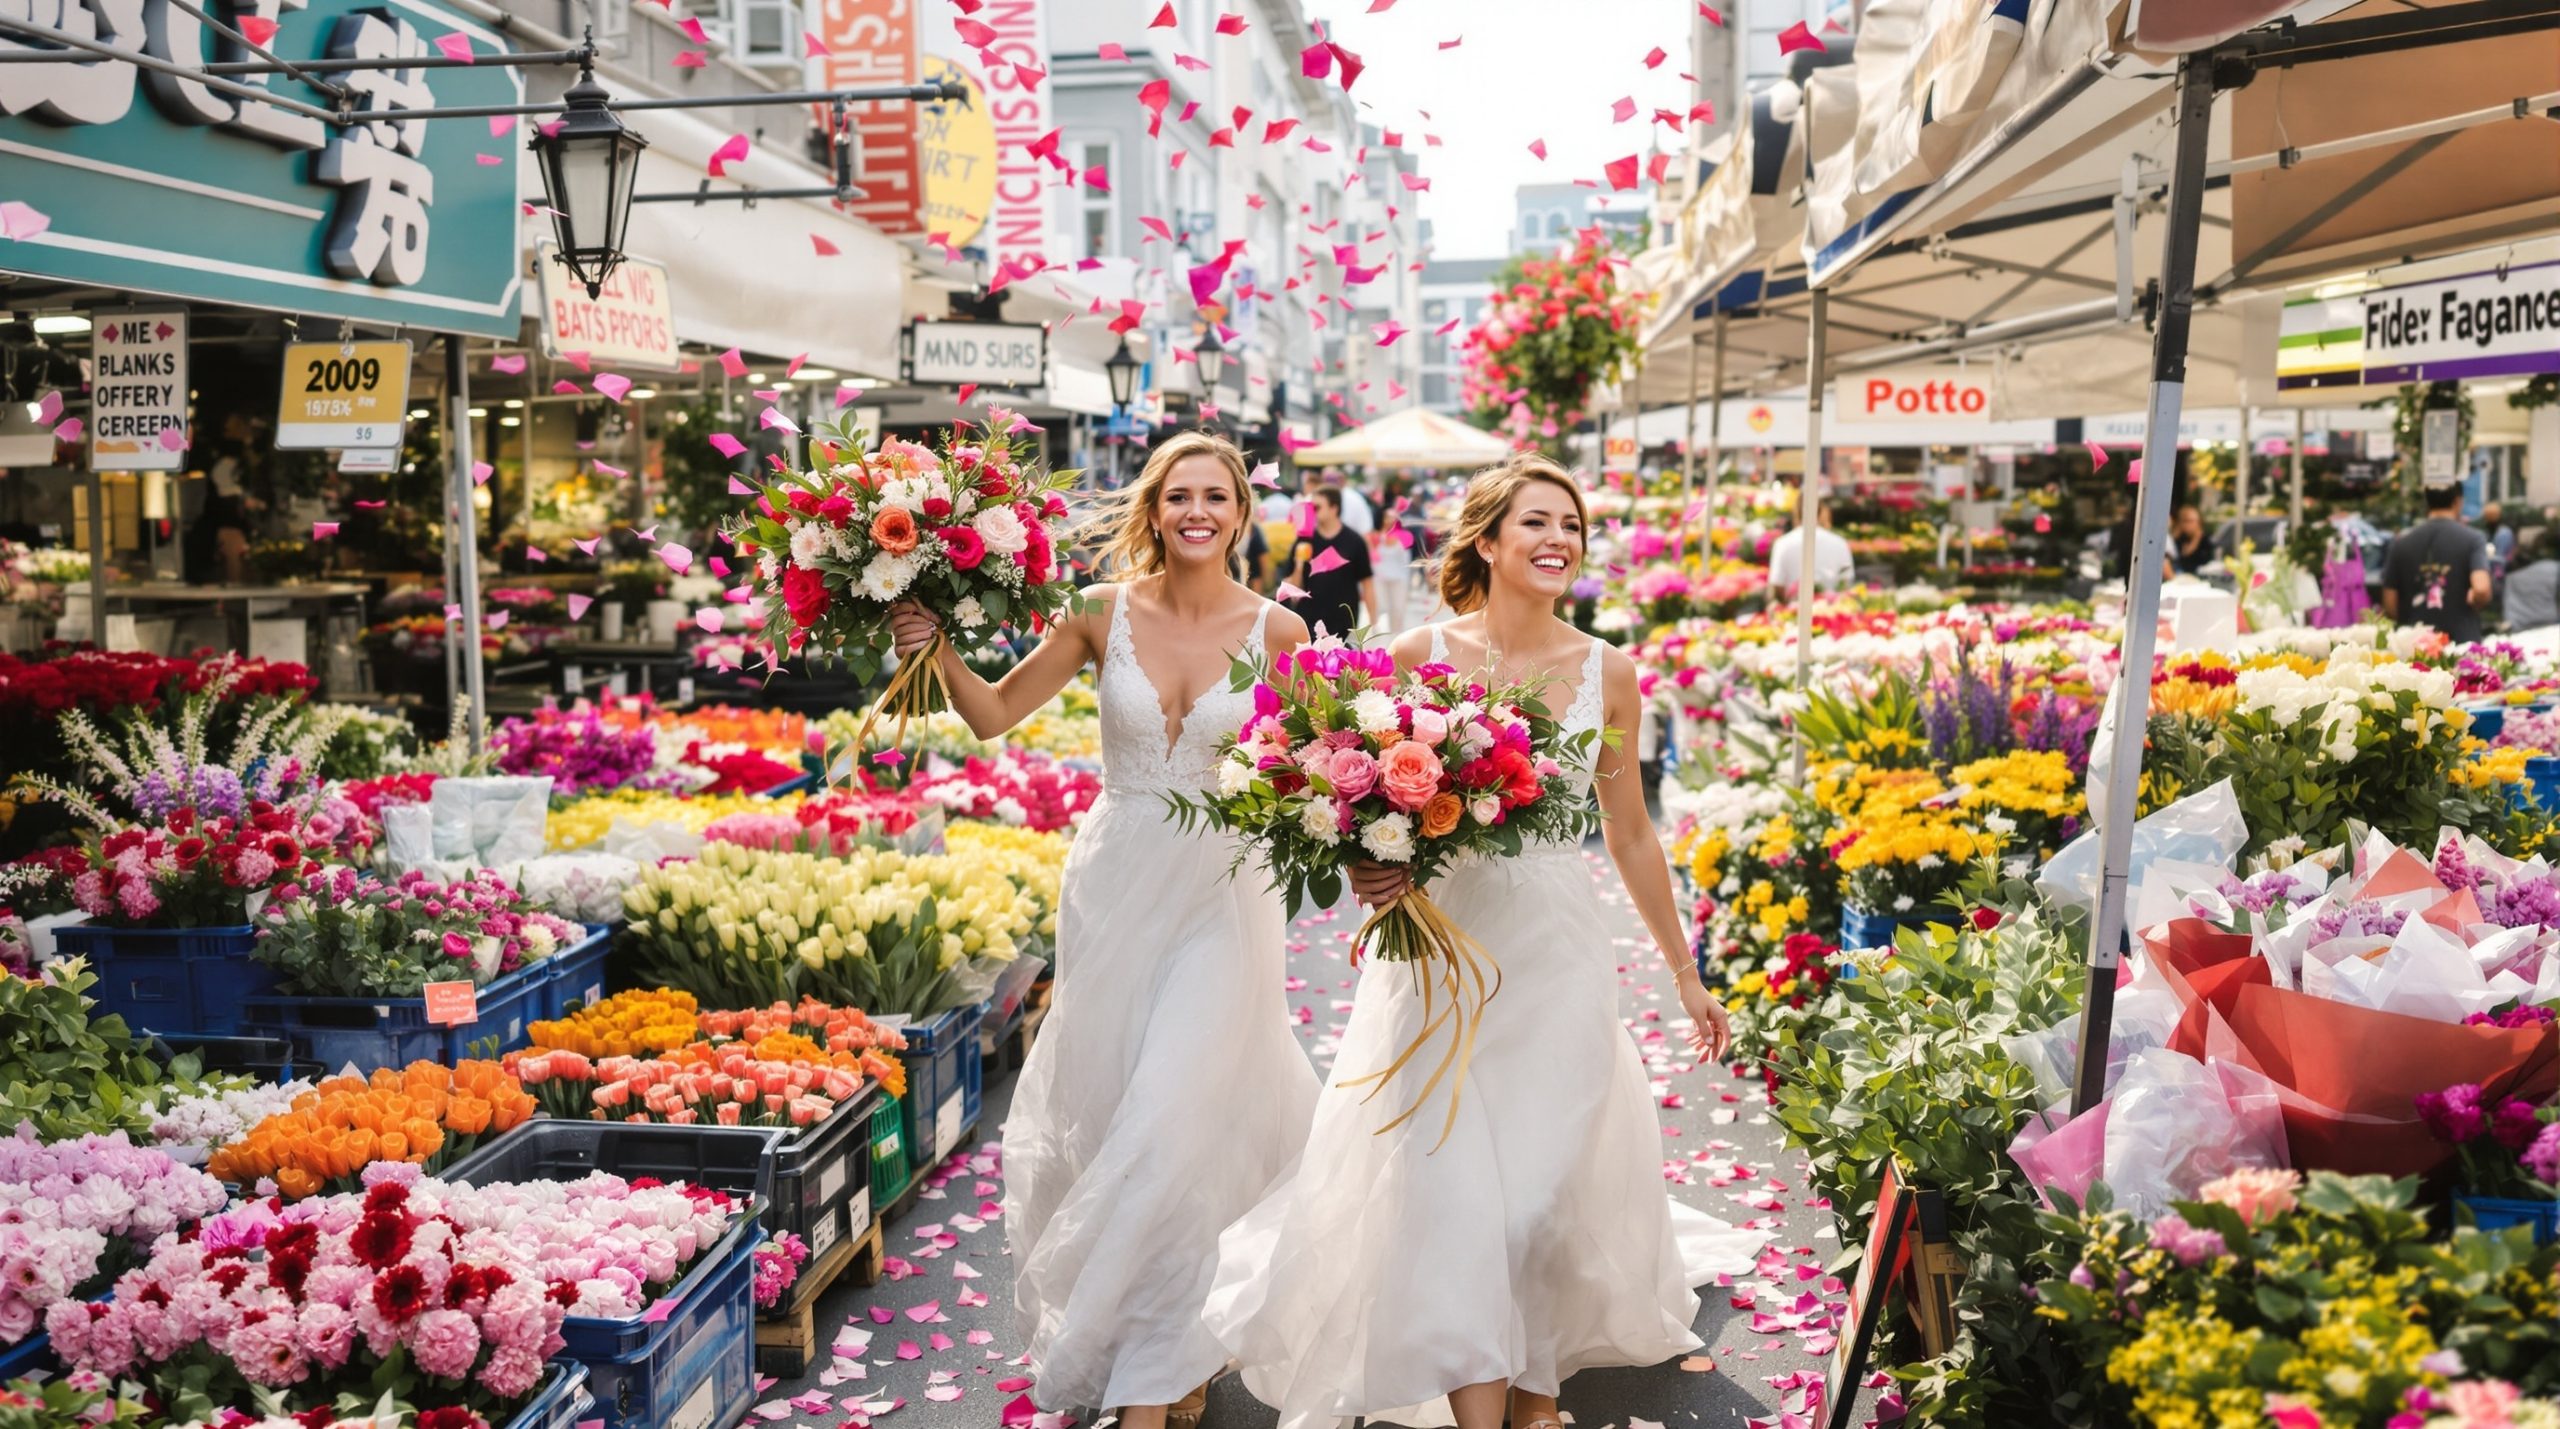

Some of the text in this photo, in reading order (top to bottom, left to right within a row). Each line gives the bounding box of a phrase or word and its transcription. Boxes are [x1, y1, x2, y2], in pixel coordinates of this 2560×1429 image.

[122, 322, 151, 344] ME
[554, 298, 606, 343] BATS
[99, 353, 175, 377] BLANKS
[922, 340, 1037, 369] MND SURS
[305, 358, 380, 393] 2009
[97, 384, 173, 407] OFFERY
[1866, 379, 1986, 414] Potto
